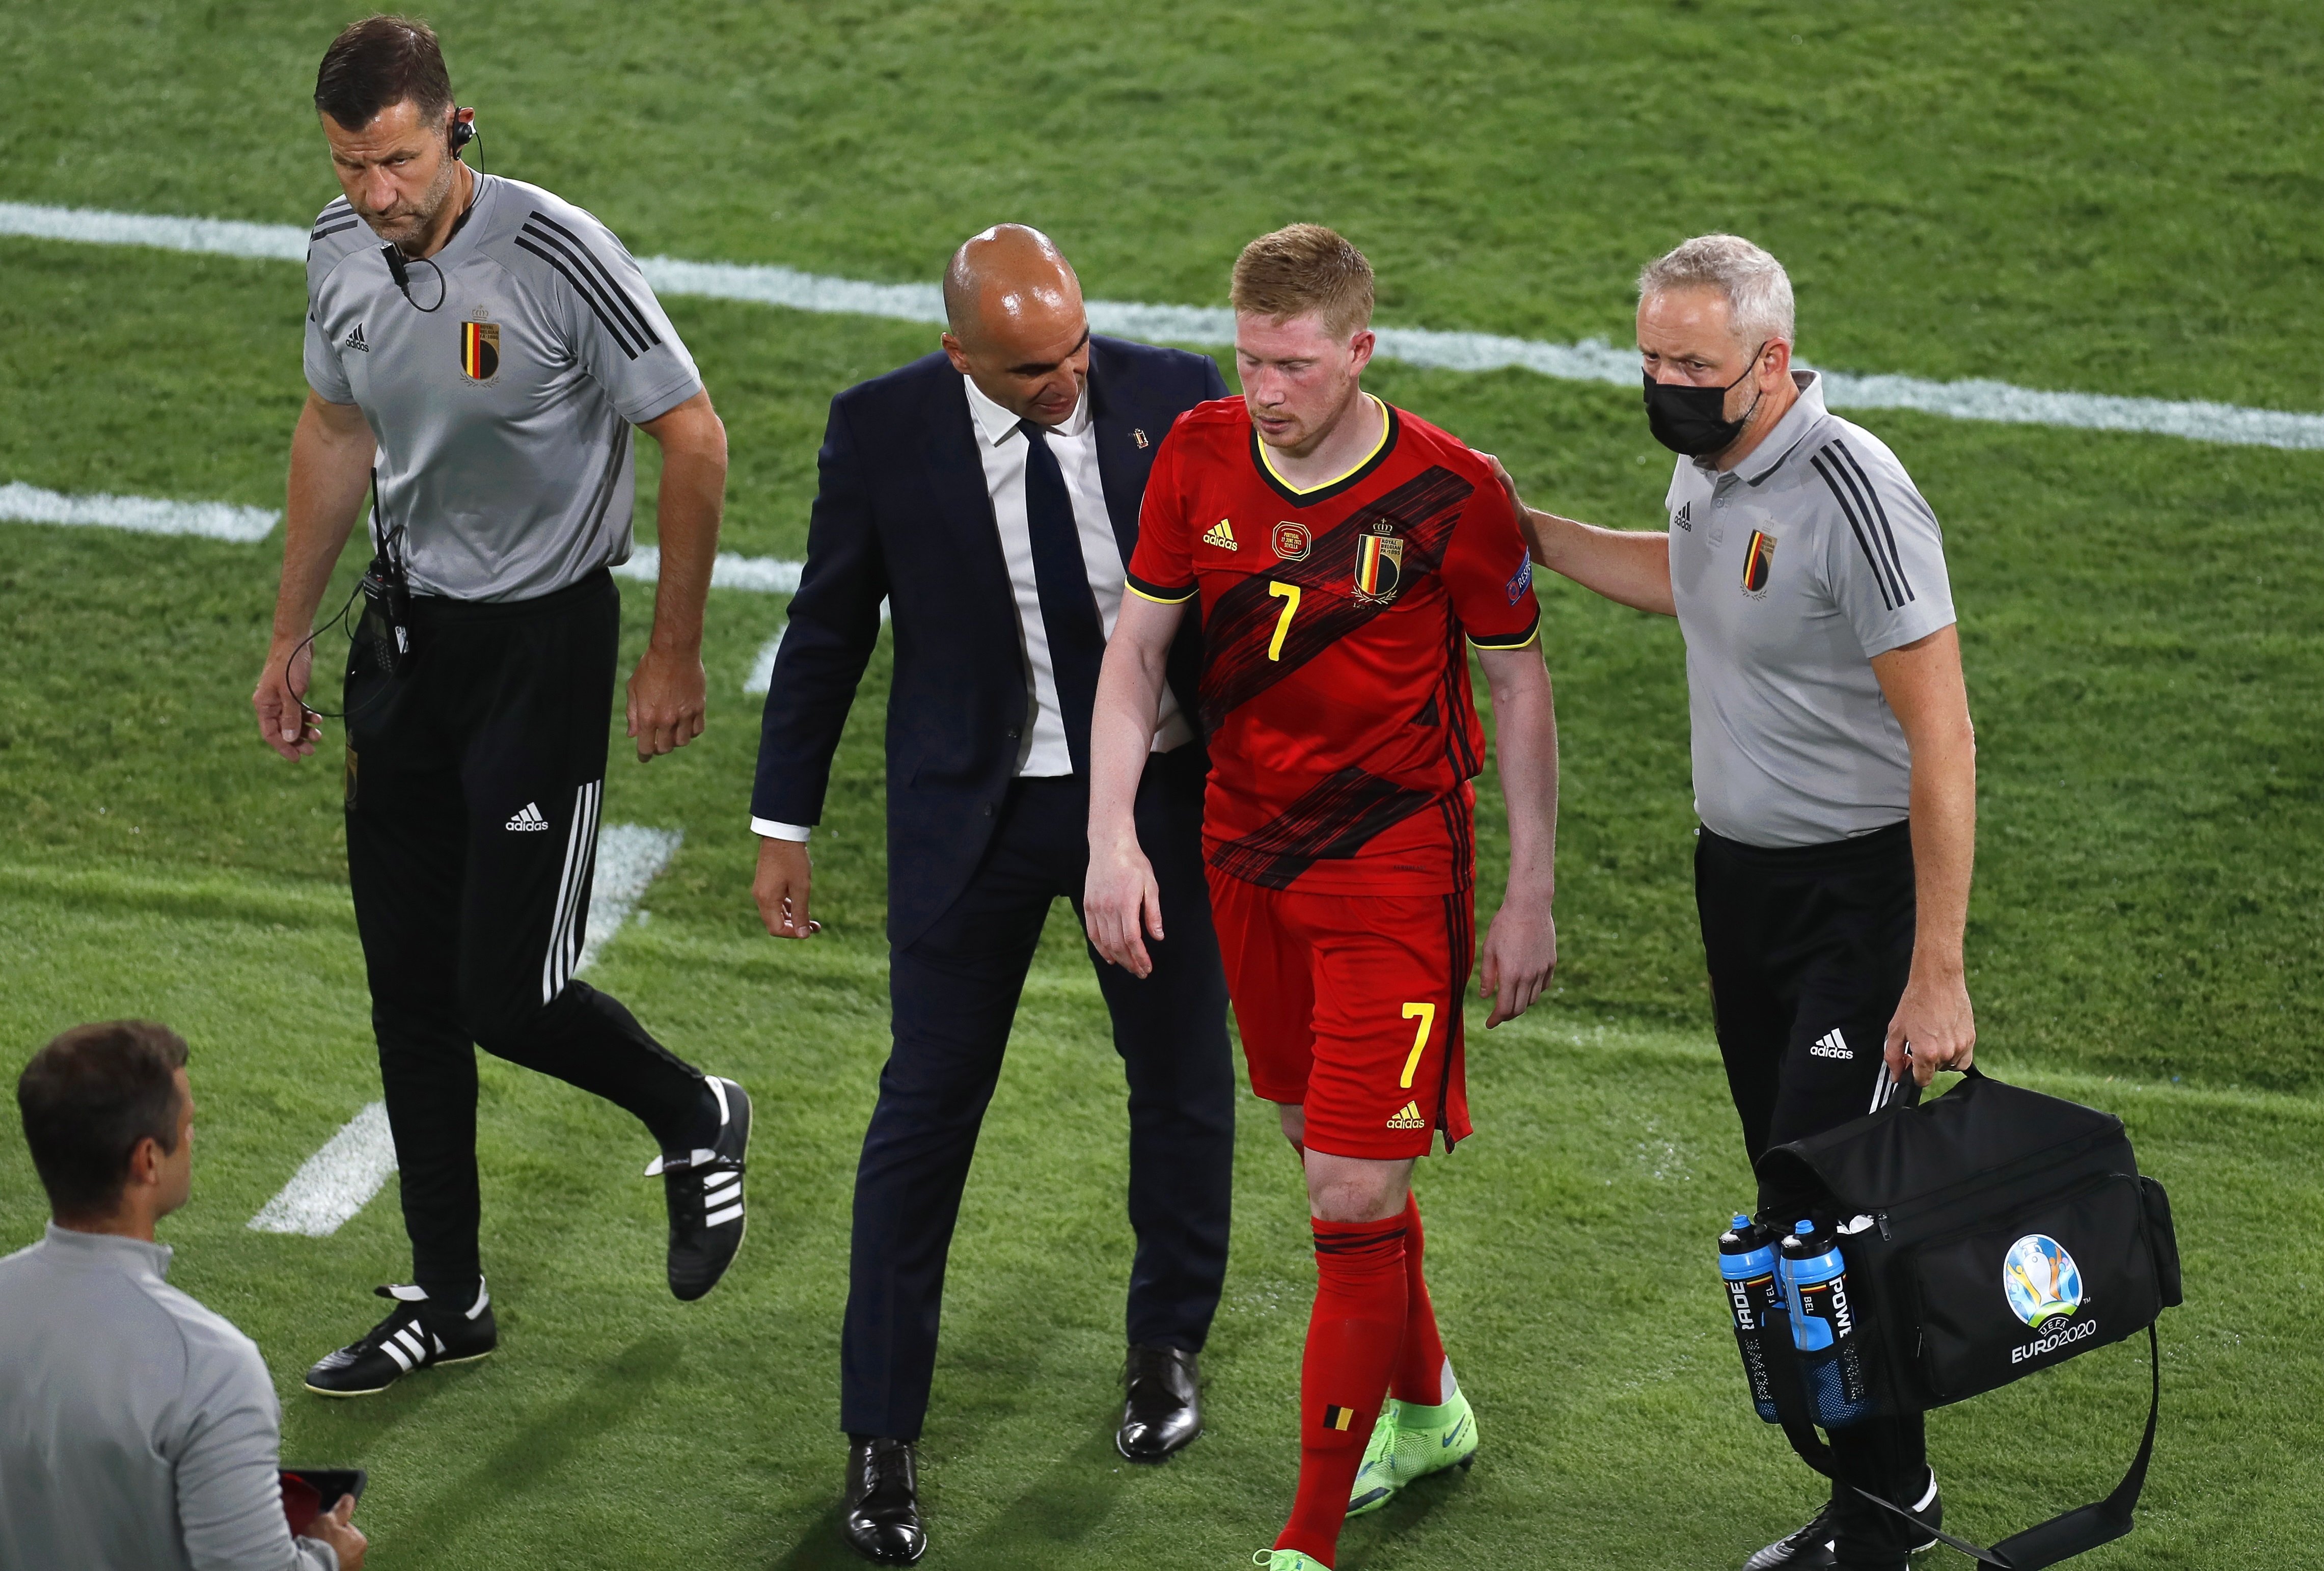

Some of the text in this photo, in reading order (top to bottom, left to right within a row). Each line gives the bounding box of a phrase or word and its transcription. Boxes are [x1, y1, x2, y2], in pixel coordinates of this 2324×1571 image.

[345, 338, 369, 353] adidas
[1674, 515, 1692, 533] adidas
[1203, 533, 1238, 552] adidas
[1269, 581, 1301, 662] 7
[505, 821, 549, 831] adidas
[1400, 1002, 1435, 1089] 7
[1810, 1045, 1853, 1060] adidas
[1386, 1119, 1425, 1129] adidas
[1803, 1296, 1814, 1314] BEL
[2040, 1319, 2066, 1335] UEFA
[2012, 1319, 2096, 1364] EURO2020
